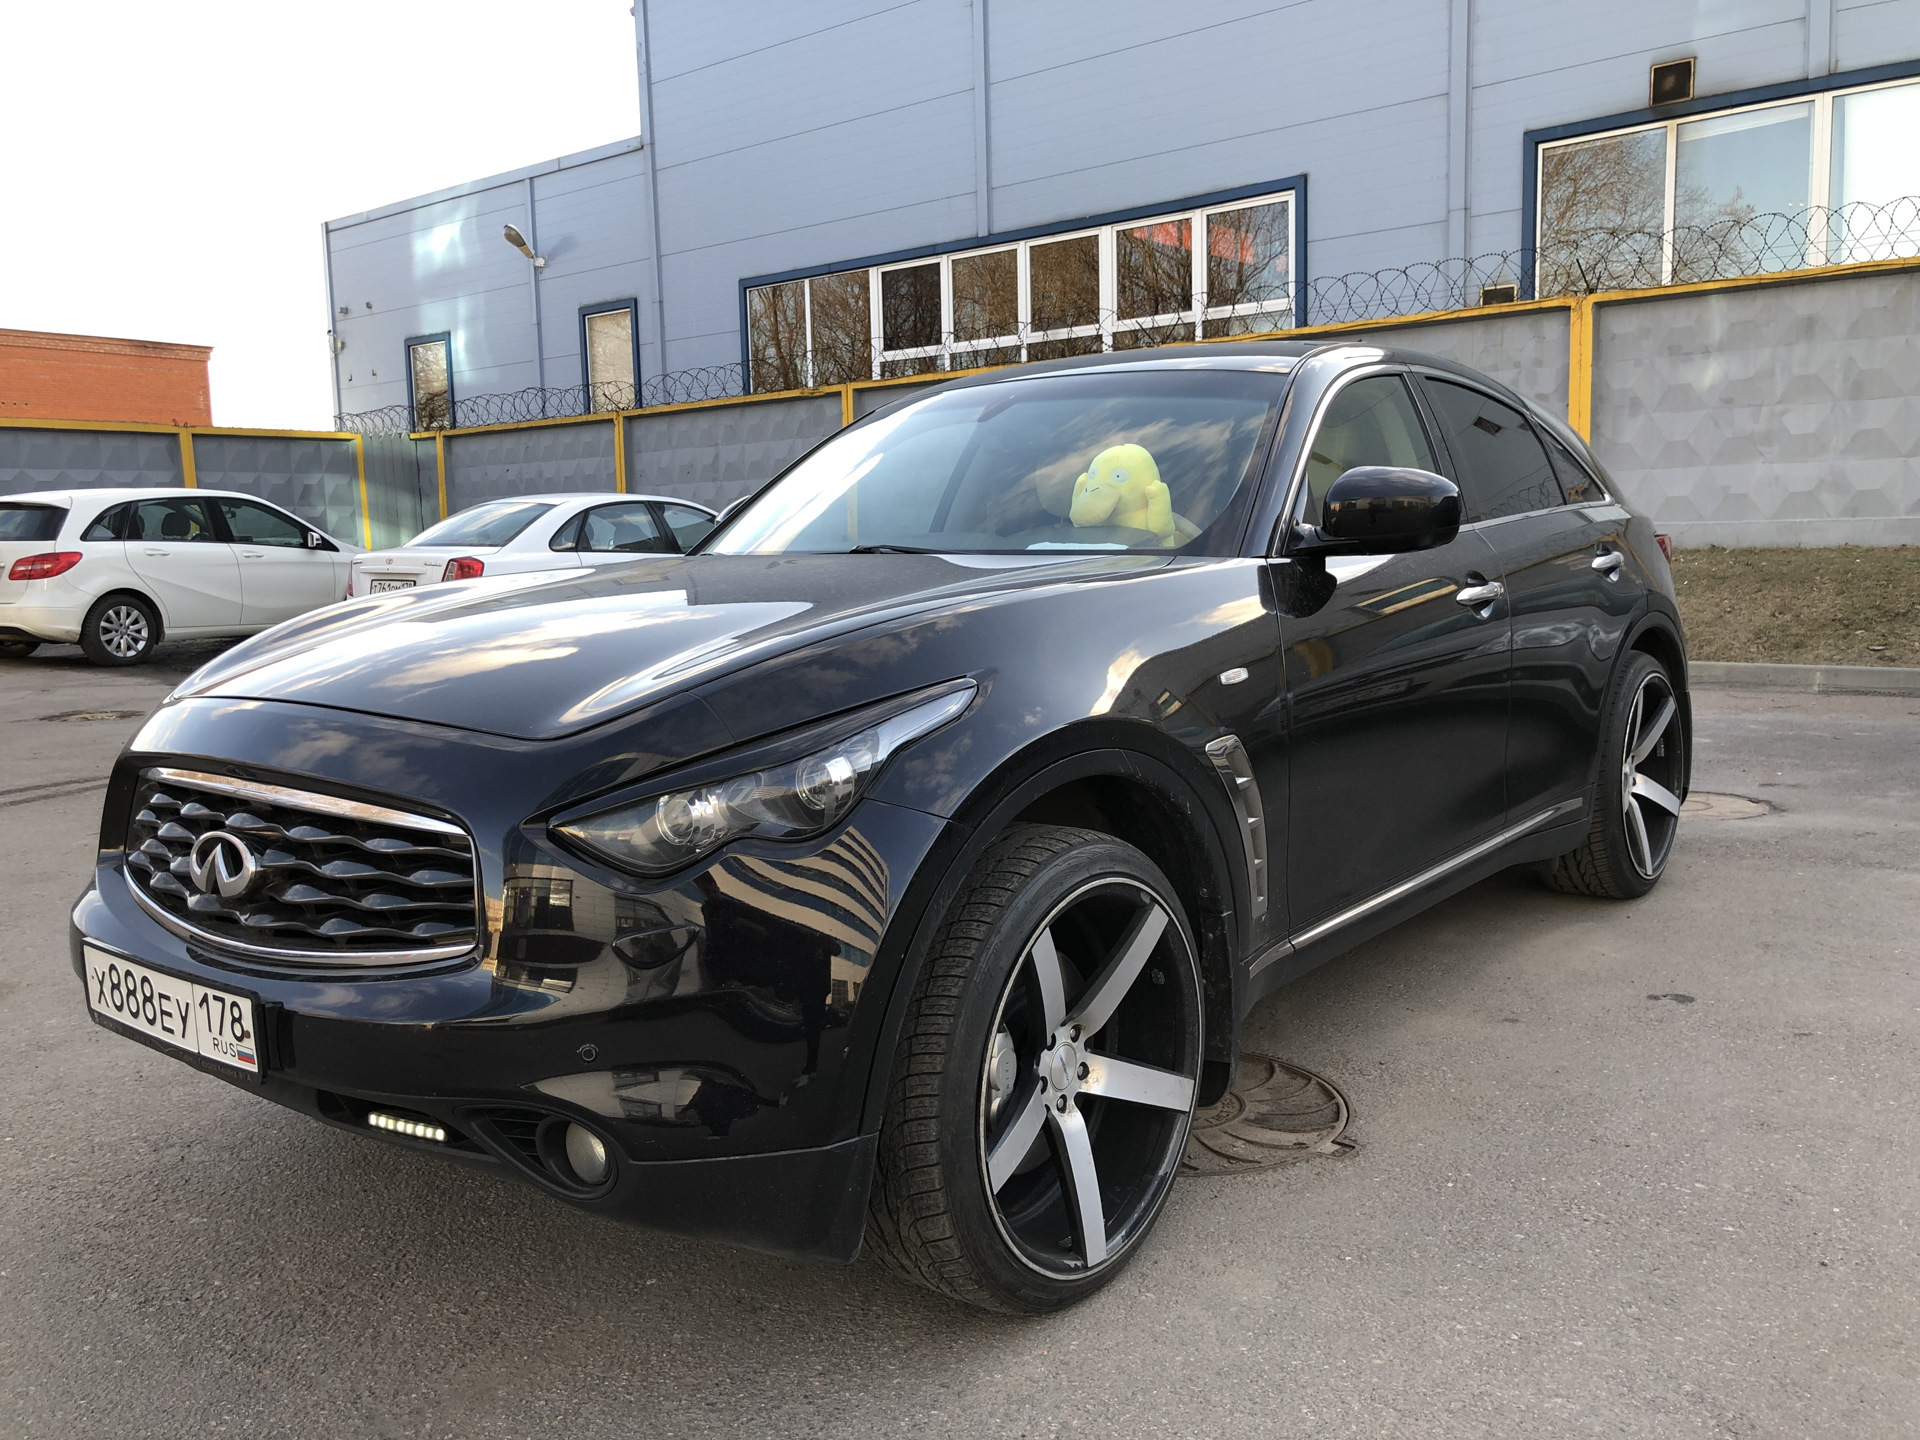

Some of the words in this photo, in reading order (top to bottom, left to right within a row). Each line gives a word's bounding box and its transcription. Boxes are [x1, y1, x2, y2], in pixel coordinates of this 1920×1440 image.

[94, 963, 190, 1039] Х888ЕУ
[198, 991, 245, 1043] 178
[212, 1037, 237, 1058] RUS
